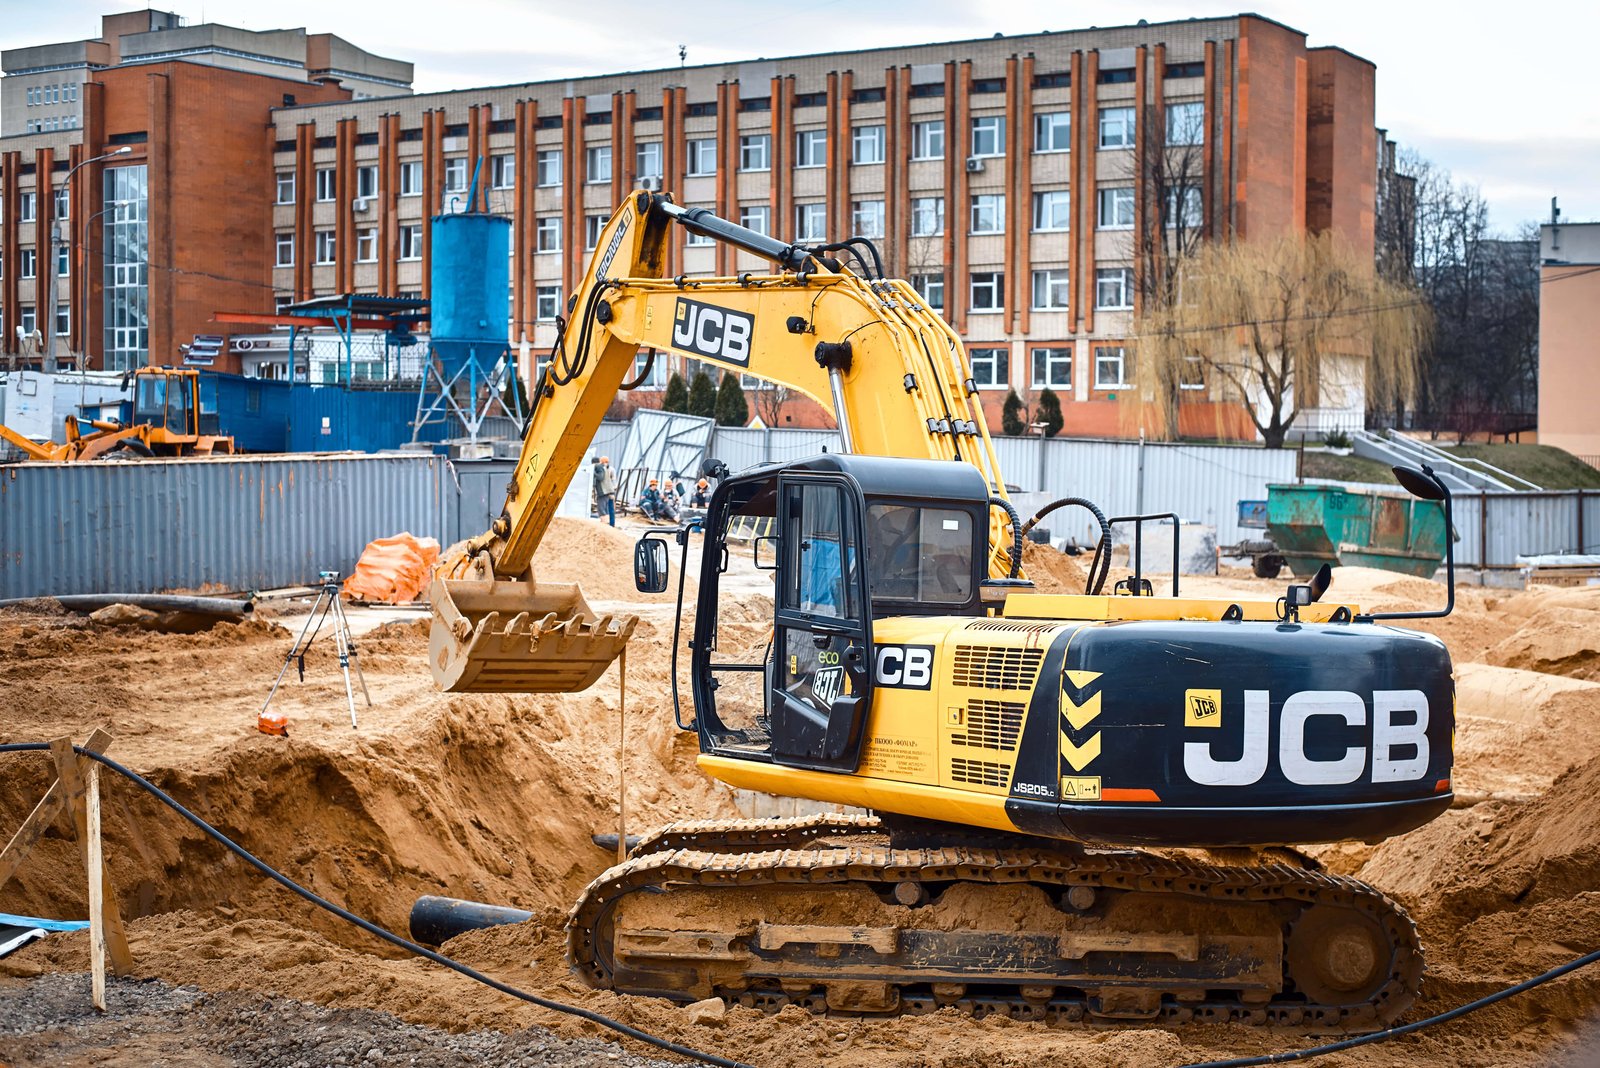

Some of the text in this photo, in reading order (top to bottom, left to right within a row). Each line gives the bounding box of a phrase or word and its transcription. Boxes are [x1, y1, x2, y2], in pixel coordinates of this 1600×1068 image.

[674, 304, 751, 362] JCB
[818, 651, 839, 665] eco
[875, 647, 931, 686] CB
[1195, 698, 1216, 717] JCB
[1184, 690, 1430, 787] JCB
